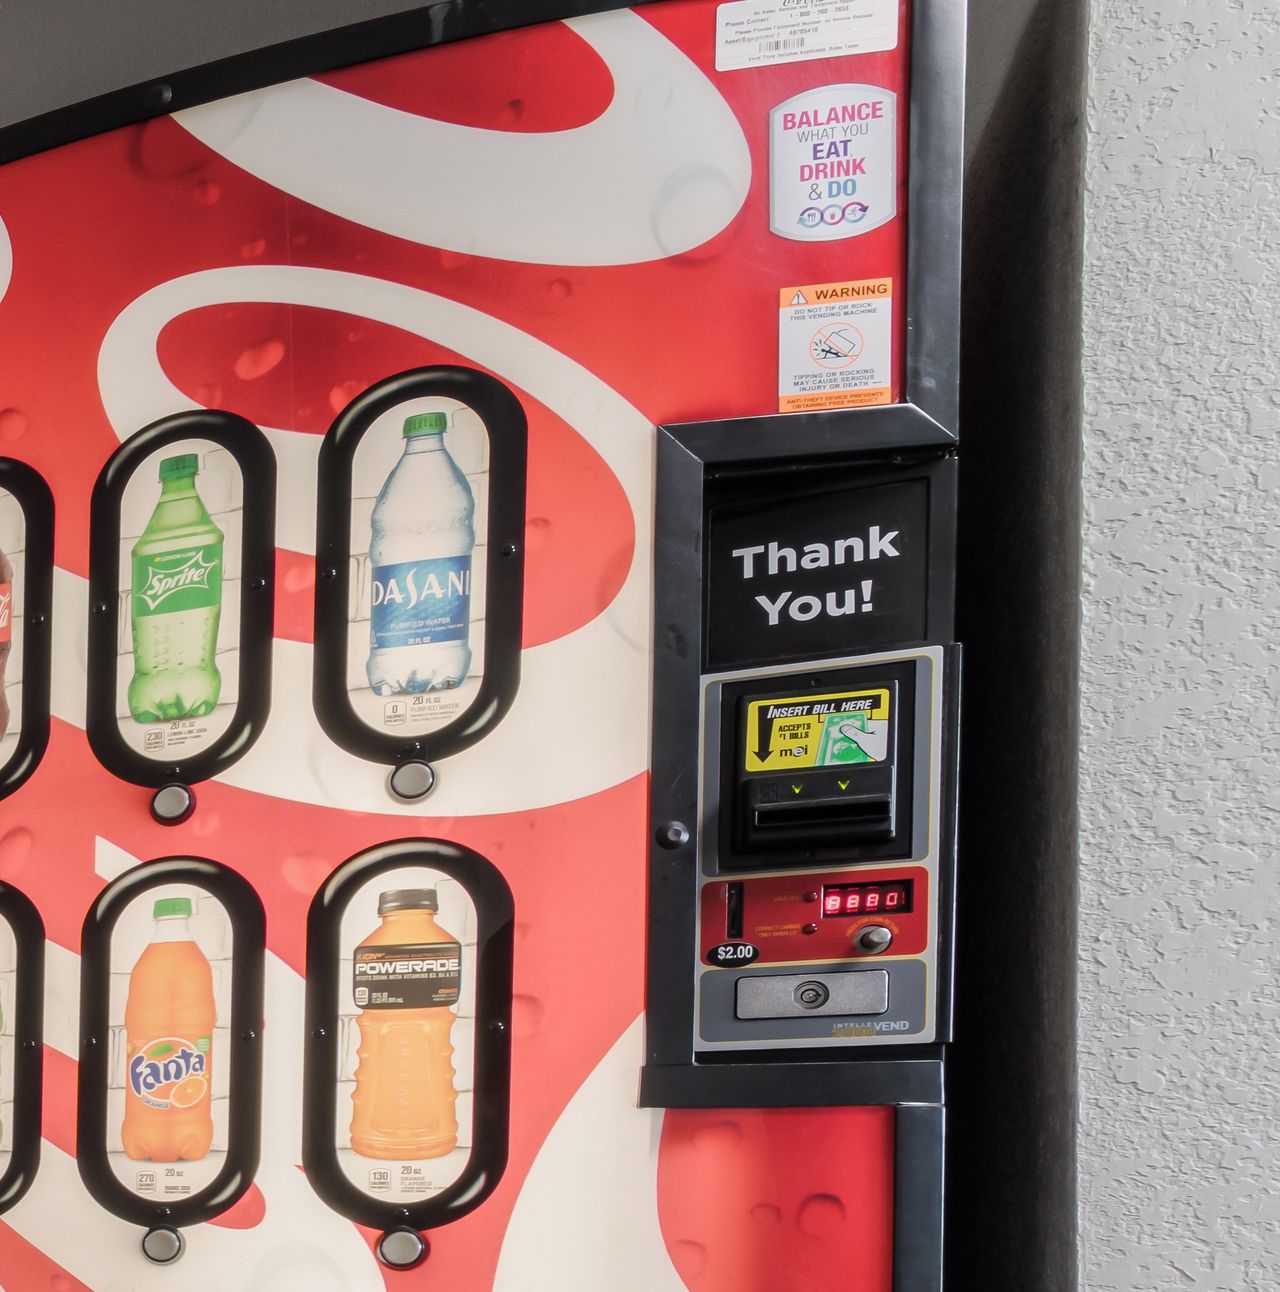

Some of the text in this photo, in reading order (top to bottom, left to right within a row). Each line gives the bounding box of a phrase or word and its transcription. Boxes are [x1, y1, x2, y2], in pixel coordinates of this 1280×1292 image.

[783, 101, 883, 131] BALANCE
[797, 123, 869, 143] WHAT YOU
[800, 157, 866, 182] DRINK
[808, 178, 857, 200] & DO
[815, 284, 887, 300] WARNING
[808, 308, 878, 320] VENDING MACHINE
[793, 372, 823, 380] TIPPING
[839, 368, 875, 376] ROCKING
[842, 381, 869, 389] DEATH
[732, 525, 900, 579] Thank
[146, 567, 205, 596] Sprite
[372, 567, 470, 610] DASANI
[754, 579, 873, 626] You!
[413, 695, 423, 705] 20
[766, 699, 873, 719] INSERT BILL HERE
[778, 723, 811, 732] ACCEPTS
[146, 732, 162, 741] 230
[789, 731, 809, 740] BILLS
[779, 745, 808, 757] mei
[718, 945, 753, 960] $2.00
[355, 959, 459, 975] POWERADE
[131, 1047, 204, 1096] Fanta
[165, 1168, 175, 1176] 20
[373, 1172, 388, 1180] 130
[401, 1166, 412, 1174] 20
[139, 1174, 154, 1182] 270
